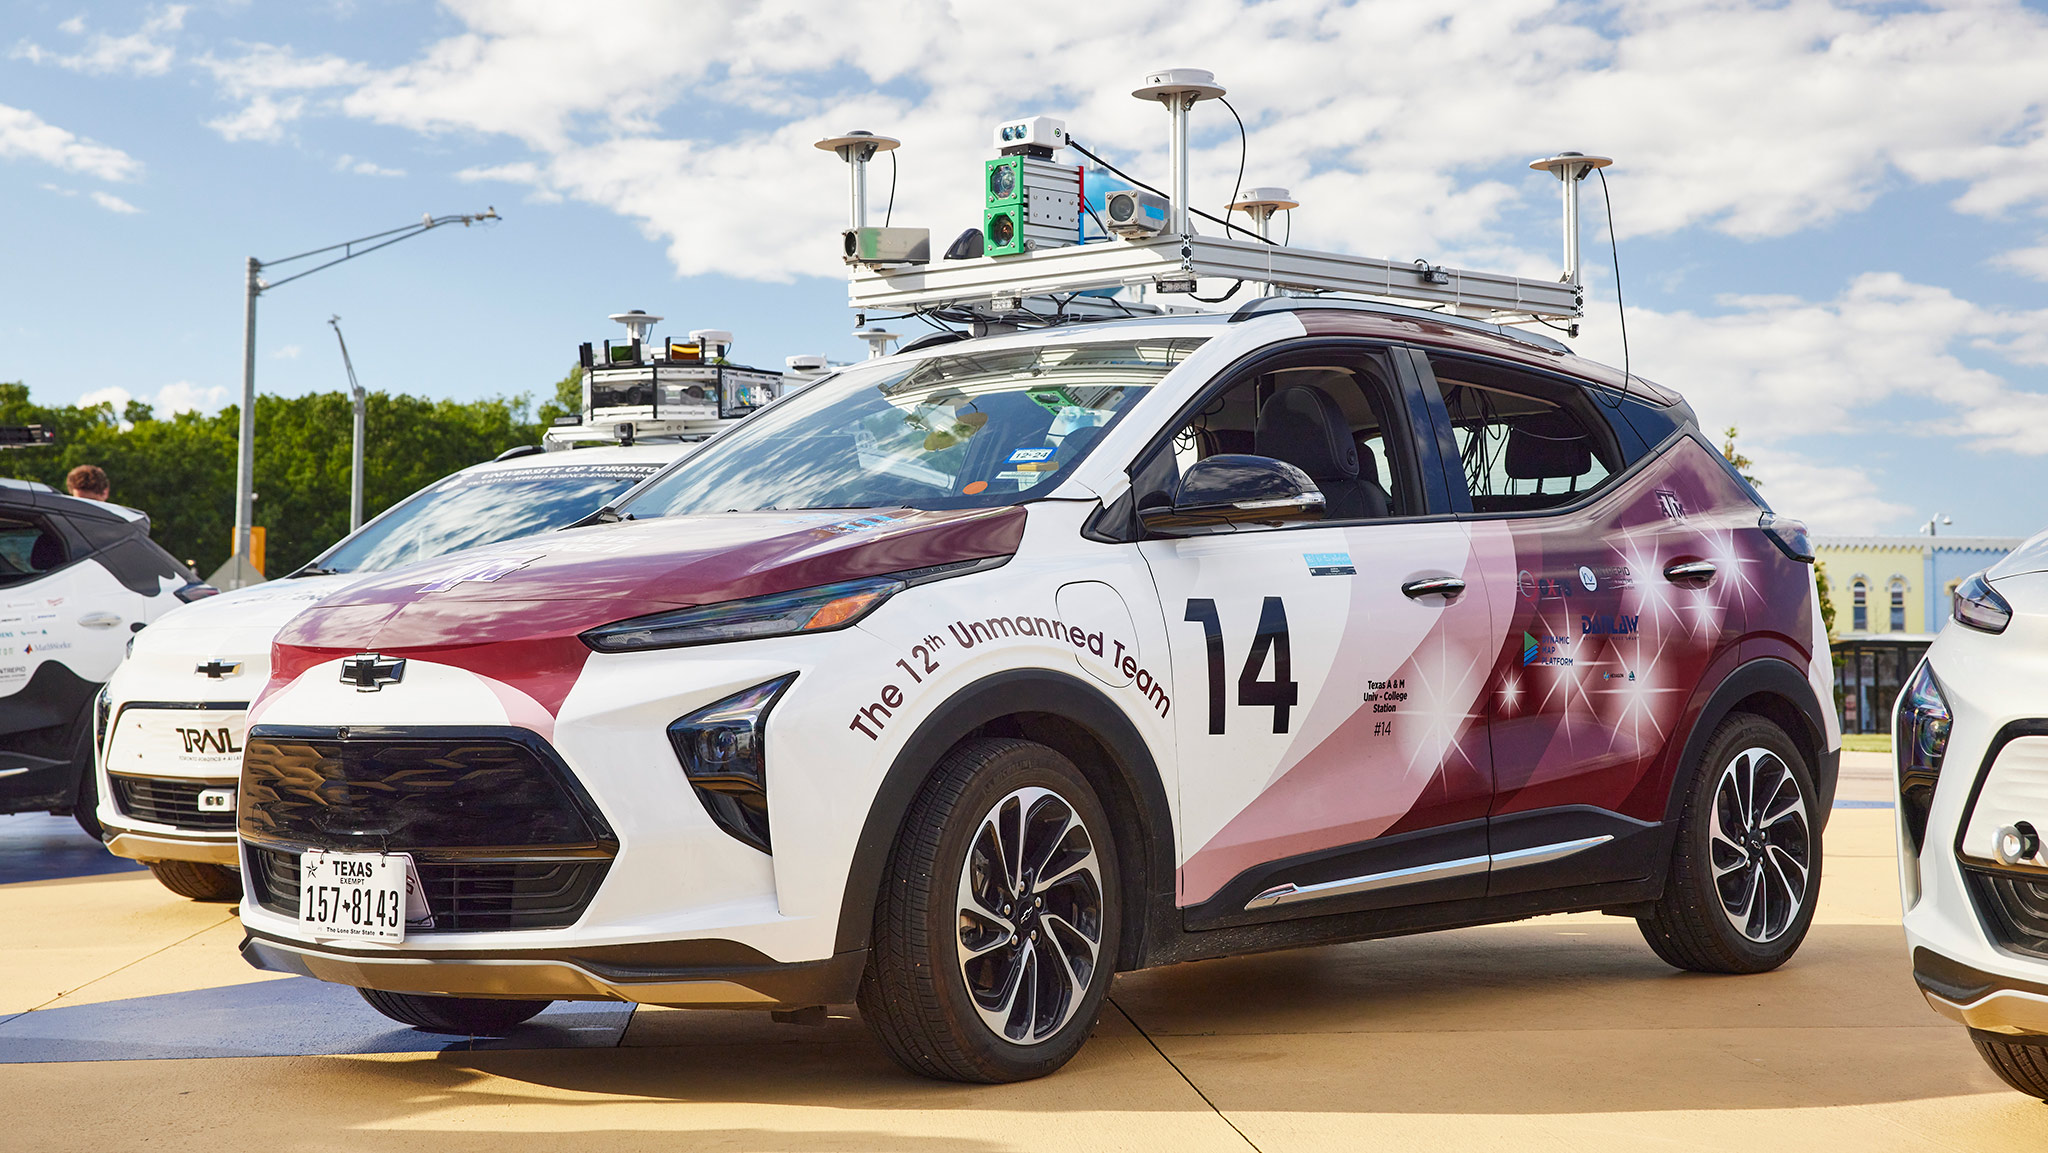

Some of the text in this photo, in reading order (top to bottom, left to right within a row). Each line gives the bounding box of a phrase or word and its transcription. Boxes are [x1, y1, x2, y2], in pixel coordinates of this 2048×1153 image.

[481, 465, 660, 480] UNIVERSITY OF TORONTO
[1581, 615, 1639, 635] DANLAW
[1541, 634, 1570, 645] DYNAMIC
[34, 641, 72, 651] MathWorks
[1541, 646, 1556, 655] MAP
[1184, 596, 1298, 735] 14
[1541, 657, 1574, 666] PLATFORM
[849, 616, 1171, 741] The 12th Unmanned Team
[1367, 680, 1386, 690] Texas
[1387, 679, 1392, 689] A
[1393, 679, 1398, 689] &
[1363, 692, 1379, 702] Univ
[1383, 691, 1408, 702] College
[1373, 703, 1397, 713] Station
[1374, 721, 1392, 736] #14
[176, 728, 242, 753] TRAIL
[332, 860, 373, 878] TEXAS
[339, 877, 365, 885] EXEMPT
